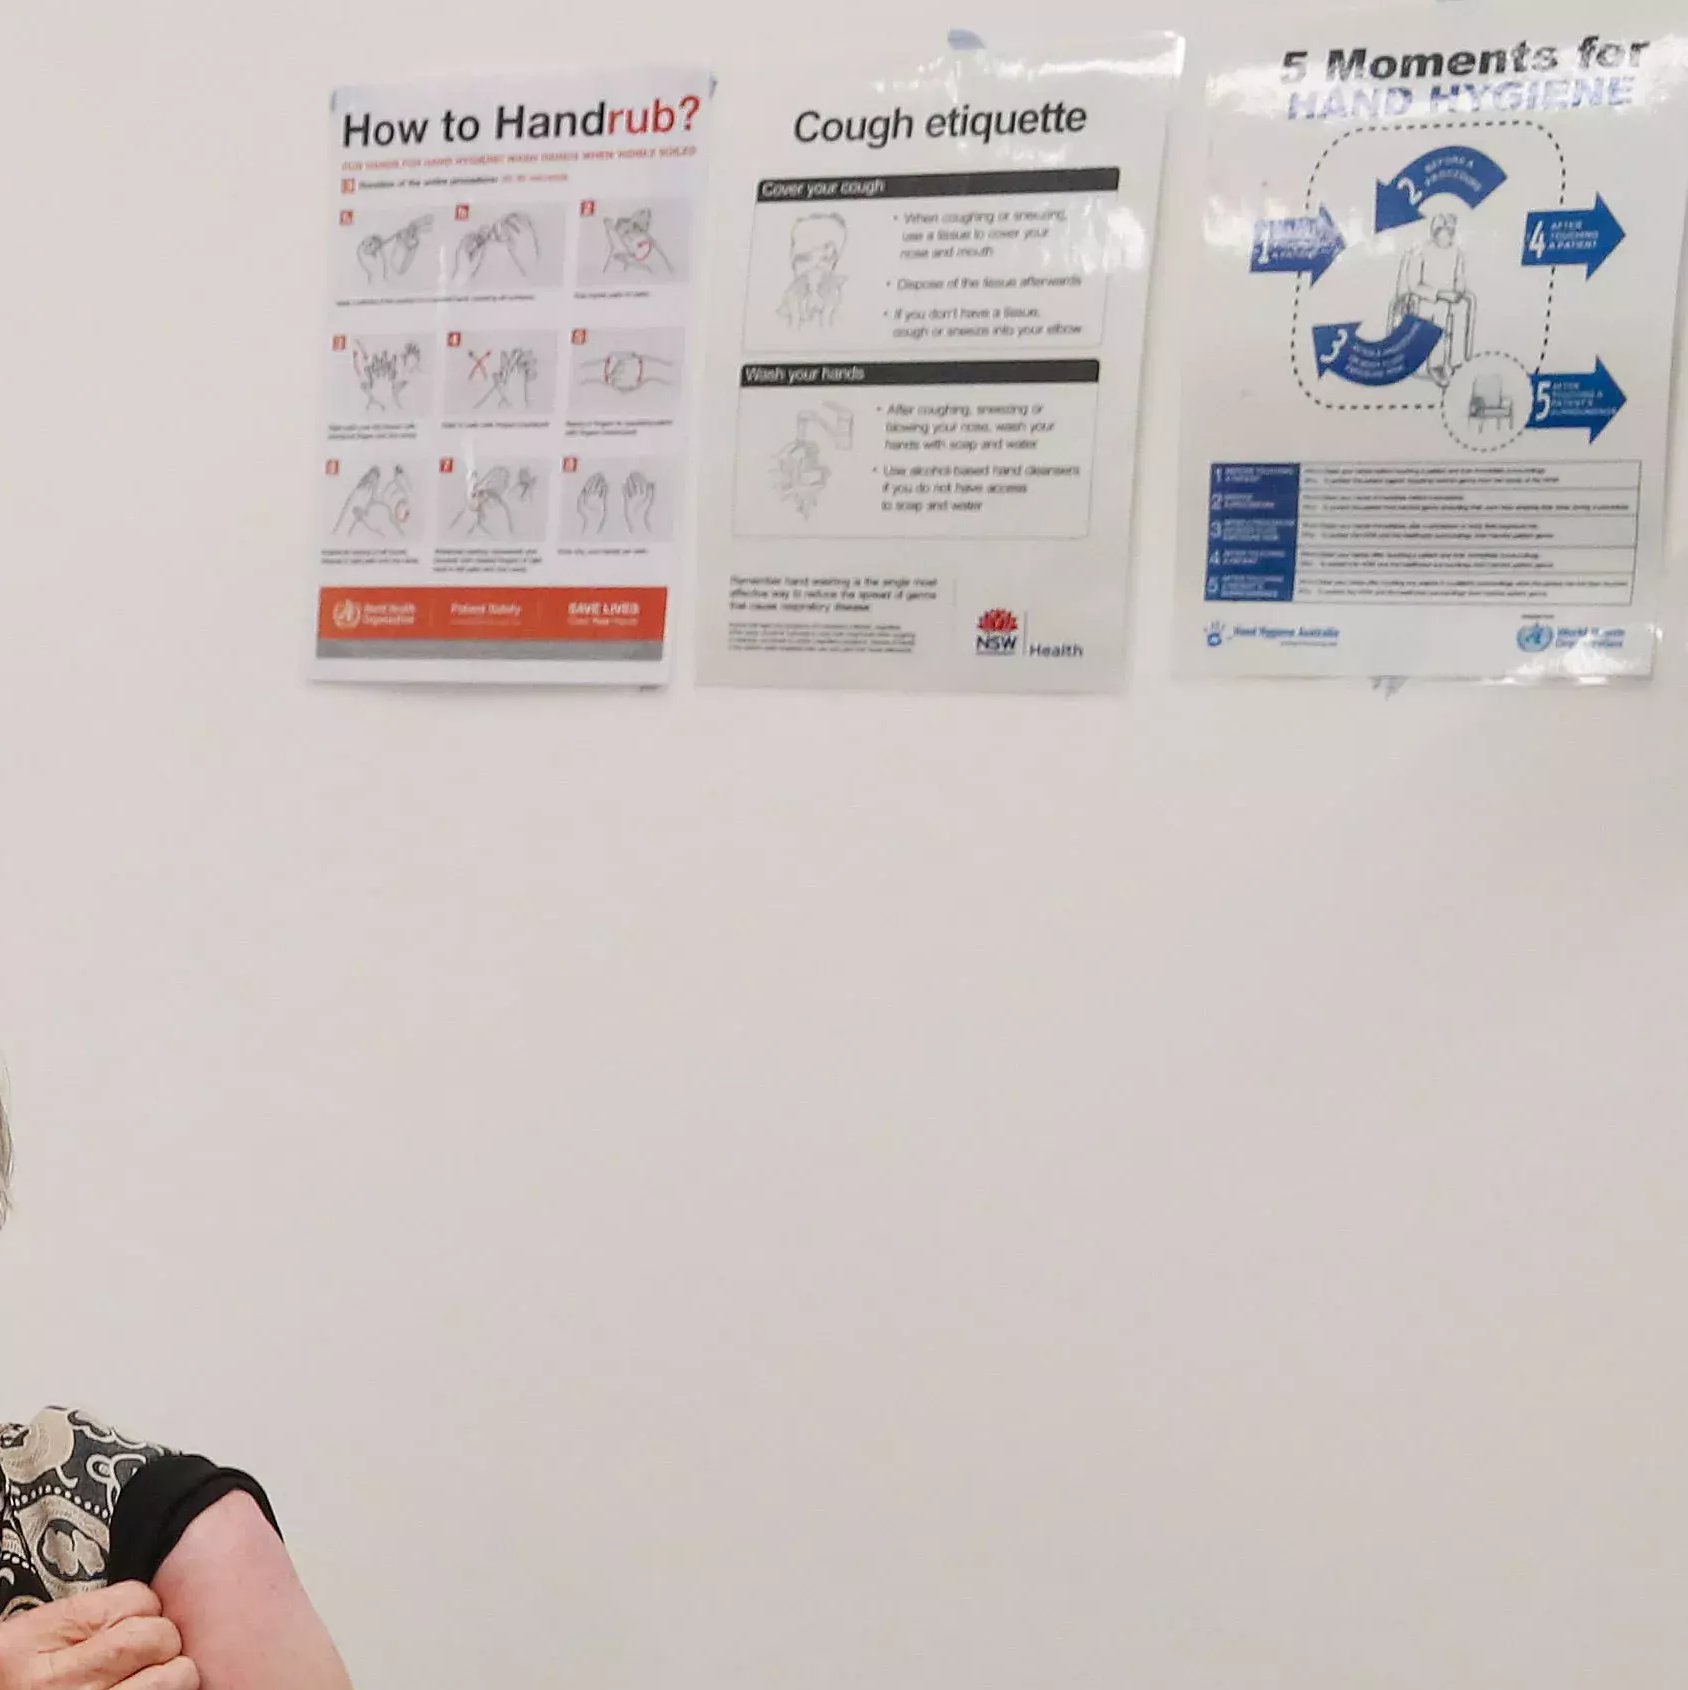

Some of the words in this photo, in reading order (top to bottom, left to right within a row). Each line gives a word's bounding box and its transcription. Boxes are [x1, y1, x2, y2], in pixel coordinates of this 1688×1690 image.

[1280, 51, 1309, 83] 5
[1325, 40, 1559, 82] Moments
[1577, 35, 1651, 69] for
[1287, 86, 1413, 120] HAND
[1431, 77, 1636, 112] HYGIENE
[342, 112, 429, 149] How
[441, 109, 480, 142] to
[495, 94, 702, 140] Handrub?
[793, 108, 913, 149] Cough
[924, 101, 1087, 143] etiquette
[761, 181, 803, 197] Cover
[806, 182, 837, 198] your
[840, 178, 886, 197] cough
[1396, 177, 1423, 206] 2
[904, 212, 938, 224] When
[942, 211, 994, 226] coughing
[1023, 226, 1050, 240] your
[1528, 219, 1546, 259] 4
[1319, 328, 1348, 364] 3
[745, 365, 784, 381] Wash
[787, 367, 818, 383] your
[821, 365, 865, 381] hands
[1535, 380, 1552, 421] 5
[886, 404, 915, 415] After
[977, 405, 1027, 416] sneezing
[932, 423, 957, 435] your
[995, 421, 1025, 432] wash
[1030, 422, 1055, 436] your
[884, 439, 920, 450] hands
[923, 439, 947, 449] with
[949, 440, 977, 452] soap
[980, 438, 1002, 449] and
[1006, 439, 1038, 449] water
[883, 464, 906, 476] Use
[992, 464, 1021, 475] hand
[891, 483, 912, 496] you
[915, 482, 930, 493] do
[933, 481, 951, 492] not
[954, 481, 983, 492] have
[895, 500, 922, 512] soap
[926, 499, 948, 510] and
[951, 499, 982, 510] water
[976, 635, 1017, 649] NSW
[1029, 643, 1084, 658] Health
